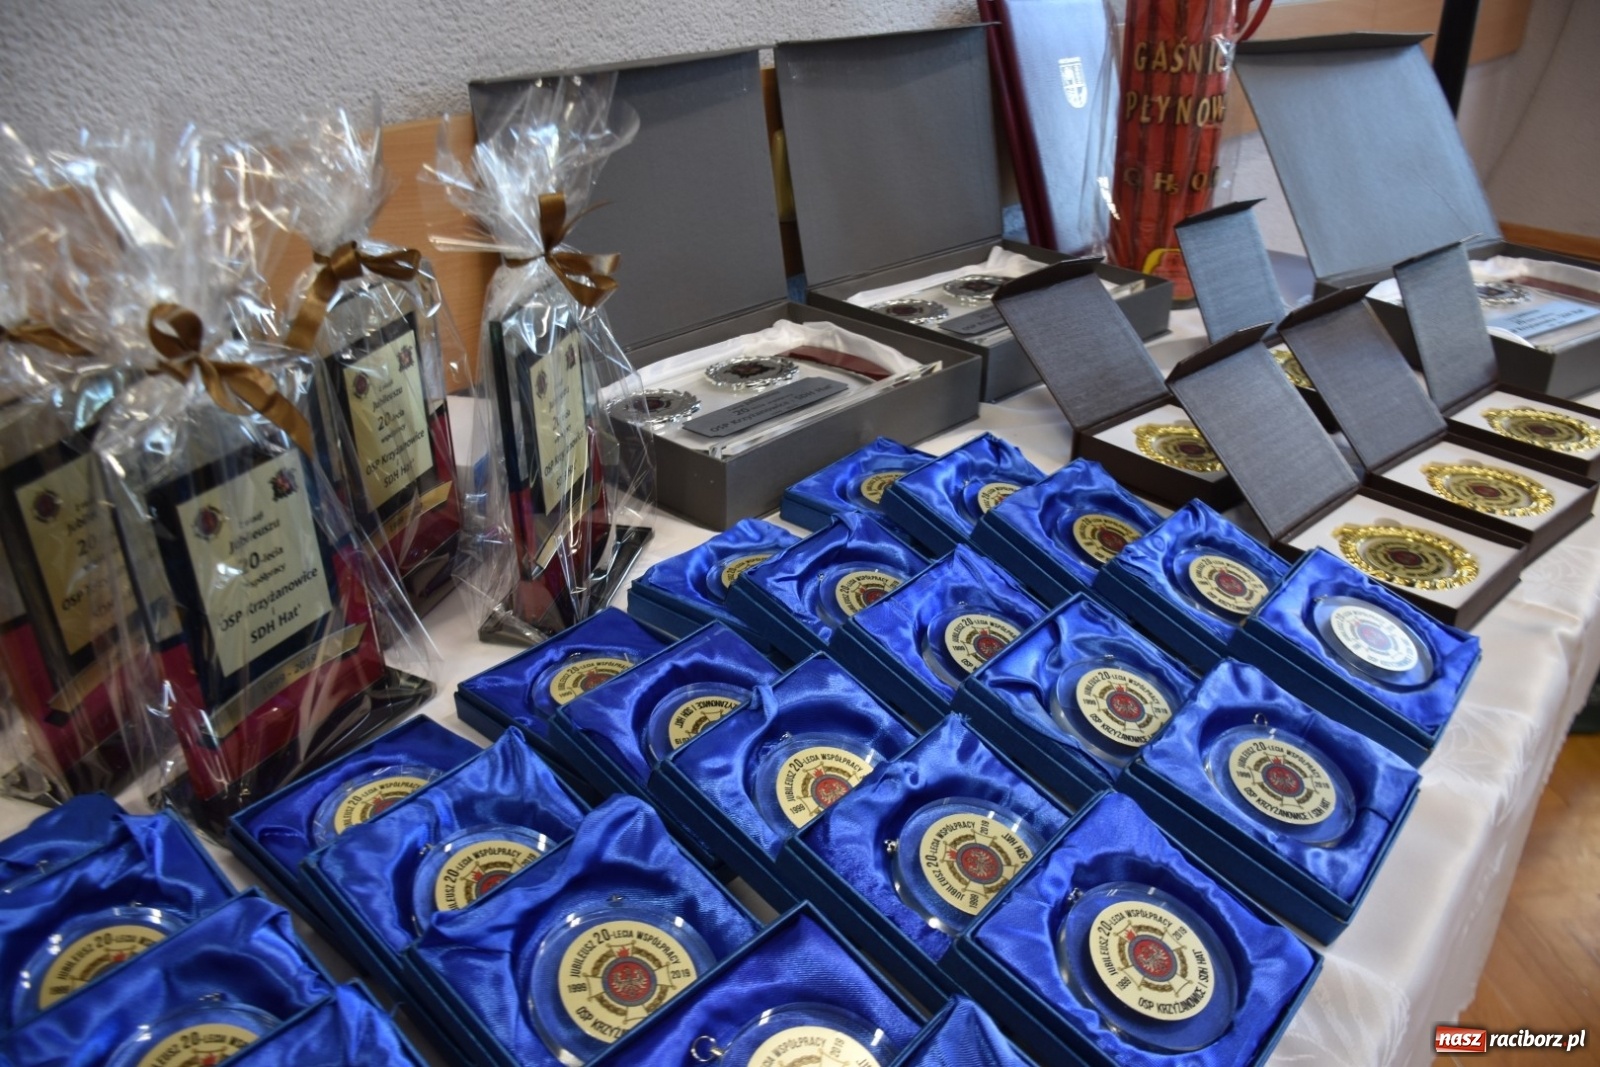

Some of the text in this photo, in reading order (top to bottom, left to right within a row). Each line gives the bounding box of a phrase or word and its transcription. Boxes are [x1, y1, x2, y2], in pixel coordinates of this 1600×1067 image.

[250, 621, 276, 644] SDH
[784, 753, 864, 802] JUBILEUSZ 20-LECIA WSPÓŁPRACY
[1243, 786, 1258, 798] OSP
[789, 803, 806, 815] 1999
[472, 847, 522, 860] WSPÓŁPRACY
[925, 820, 976, 902] JUBILEUSZ 20-LECIA WSPÓŁPRACY
[570, 928, 681, 978] JUBILEUSZ 20-LECIA WSPÓŁPRACY
[1097, 908, 1173, 977] JUBILEUSZ 20-LECIA WSPÓŁPRACY
[1138, 997, 1154, 1010] OSP
[1157, 986, 1206, 1015] KRZYŻANOWICE
[1198, 966, 1210, 983] SDH
[576, 1006, 595, 1021] OSP
[775, 1036, 828, 1058] WSPÓŁPRACY
